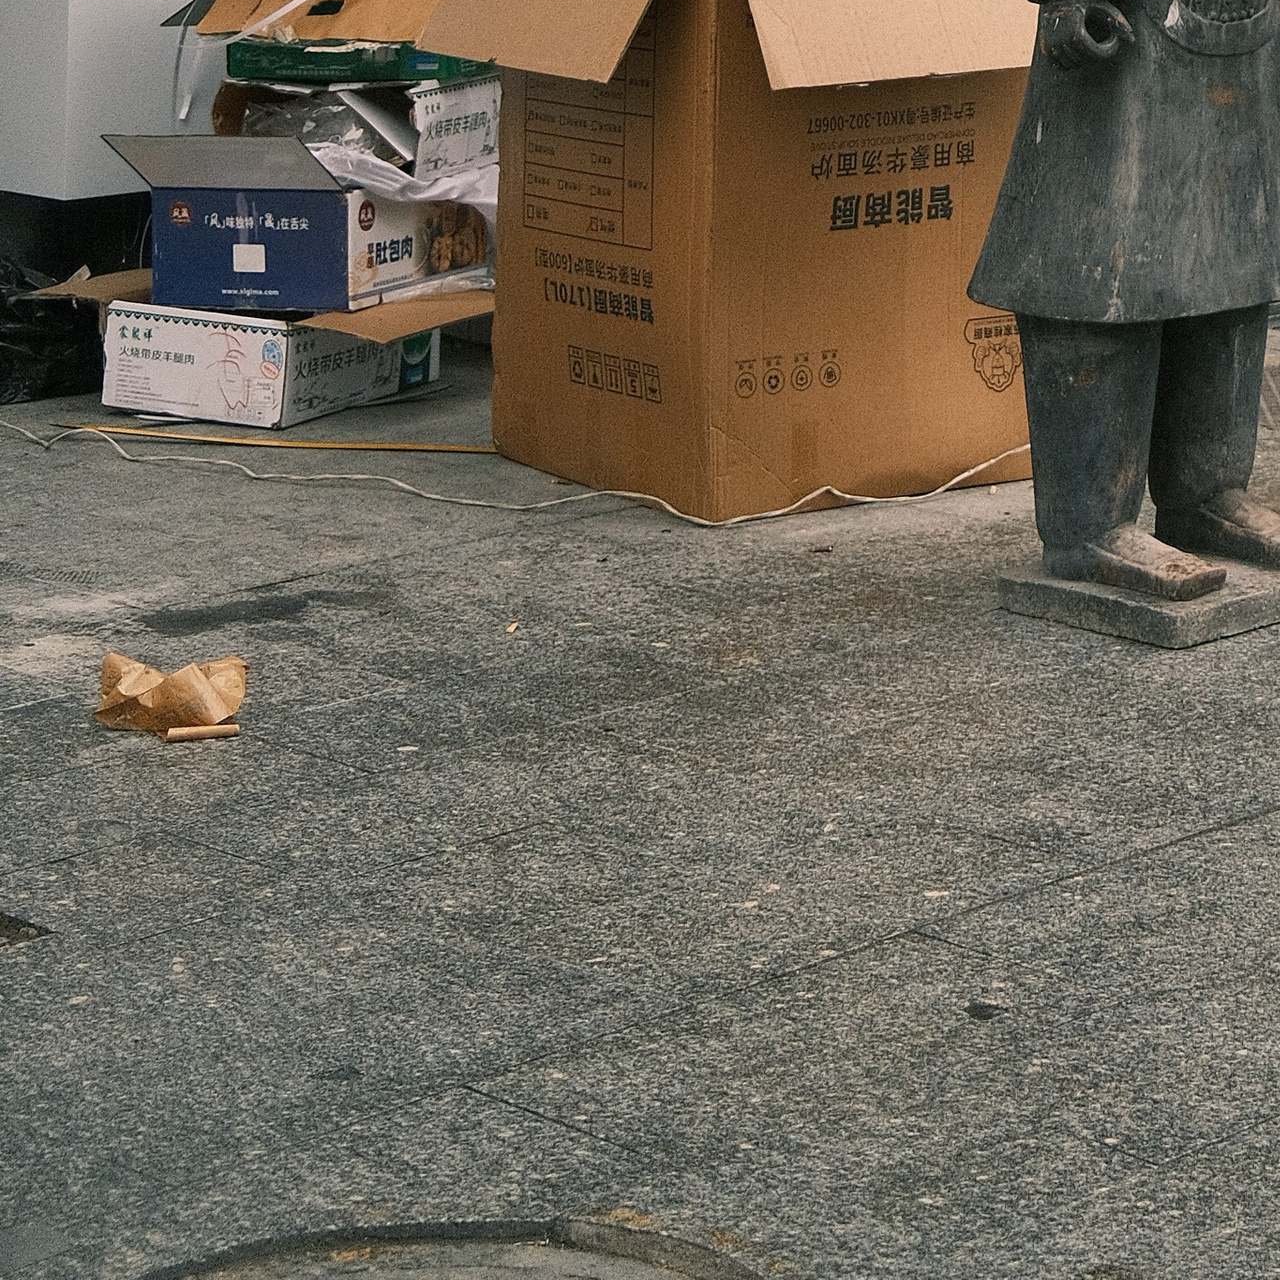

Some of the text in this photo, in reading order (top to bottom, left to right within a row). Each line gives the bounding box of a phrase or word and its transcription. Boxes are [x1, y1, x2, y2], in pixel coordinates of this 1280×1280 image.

[810, 140, 976, 181] 商用豪华汤面炉
[829, 185, 954, 232] 智能商厨
[375, 235, 413, 266] 肚包肉
[119, 345, 195, 366] 火烧带皮羊腿肉
